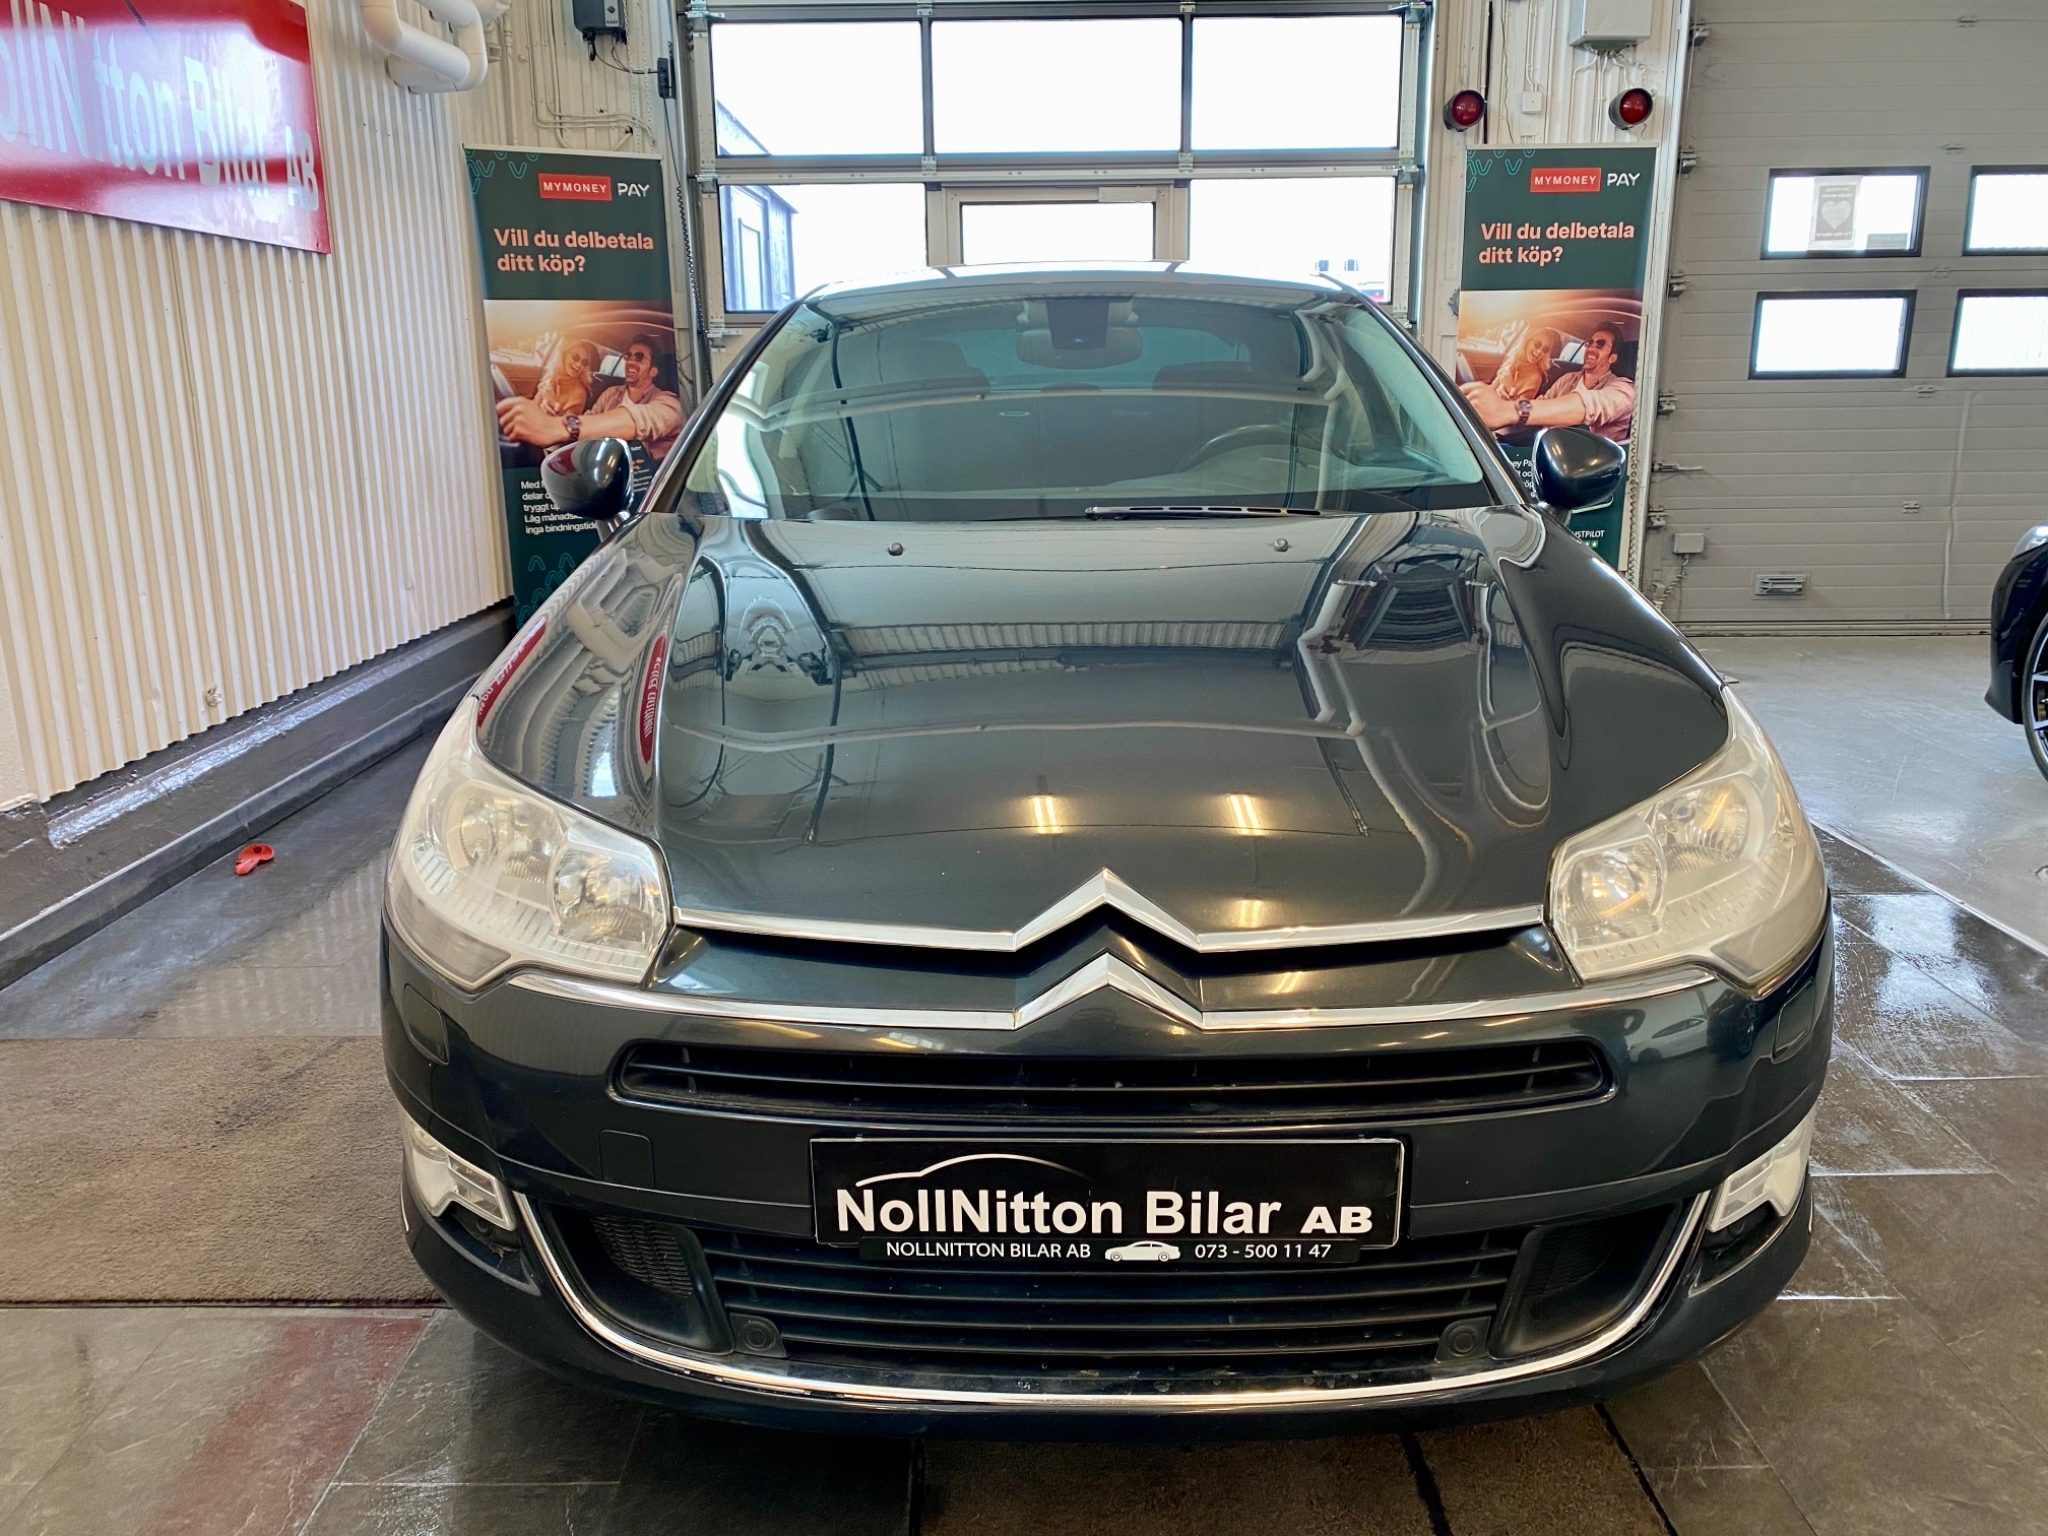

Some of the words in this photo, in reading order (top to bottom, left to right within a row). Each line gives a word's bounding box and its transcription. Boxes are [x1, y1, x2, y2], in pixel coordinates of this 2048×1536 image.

[285, 125, 319, 211] AB
[1535, 175, 1597, 185] MYMONEY
[1607, 173, 1641, 187] PAY
[543, 181, 607, 193] MYMONEY
[618, 183, 650, 197] PAY
[494, 228, 529, 247] Vill
[534, 230, 559, 248] du
[564, 231, 654, 250] delbetala
[1481, 223, 1512, 240] Vill
[1517, 223, 1541, 240] du
[1546, 222, 1635, 239] delbetala
[1478, 247, 1513, 264] ditt
[1518, 246, 1563, 266] köp?
[497, 253, 534, 271] ditt
[538, 255, 586, 276] köp?
[520, 481, 540, 489] Med
[521, 492, 544, 500] delar
[523, 503, 549, 512] tryggt
[524, 515, 541, 524] Låg
[525, 525, 544, 535] inga
[836, 1189, 1122, 1234] NollNitton
[1146, 1191, 1282, 1235] Bilar
[1300, 1206, 1373, 1234] AB
[886, 1241, 1004, 1257] NOLLNITTON
[1010, 1243, 1062, 1258] BILAR
[1066, 1244, 1091, 1258] AB
[1195, 1244, 1228, 1258] 073
[1244, 1244, 1277, 1258] 500
[1284, 1244, 1302, 1258] 11
[1308, 1244, 1331, 1258] 47
